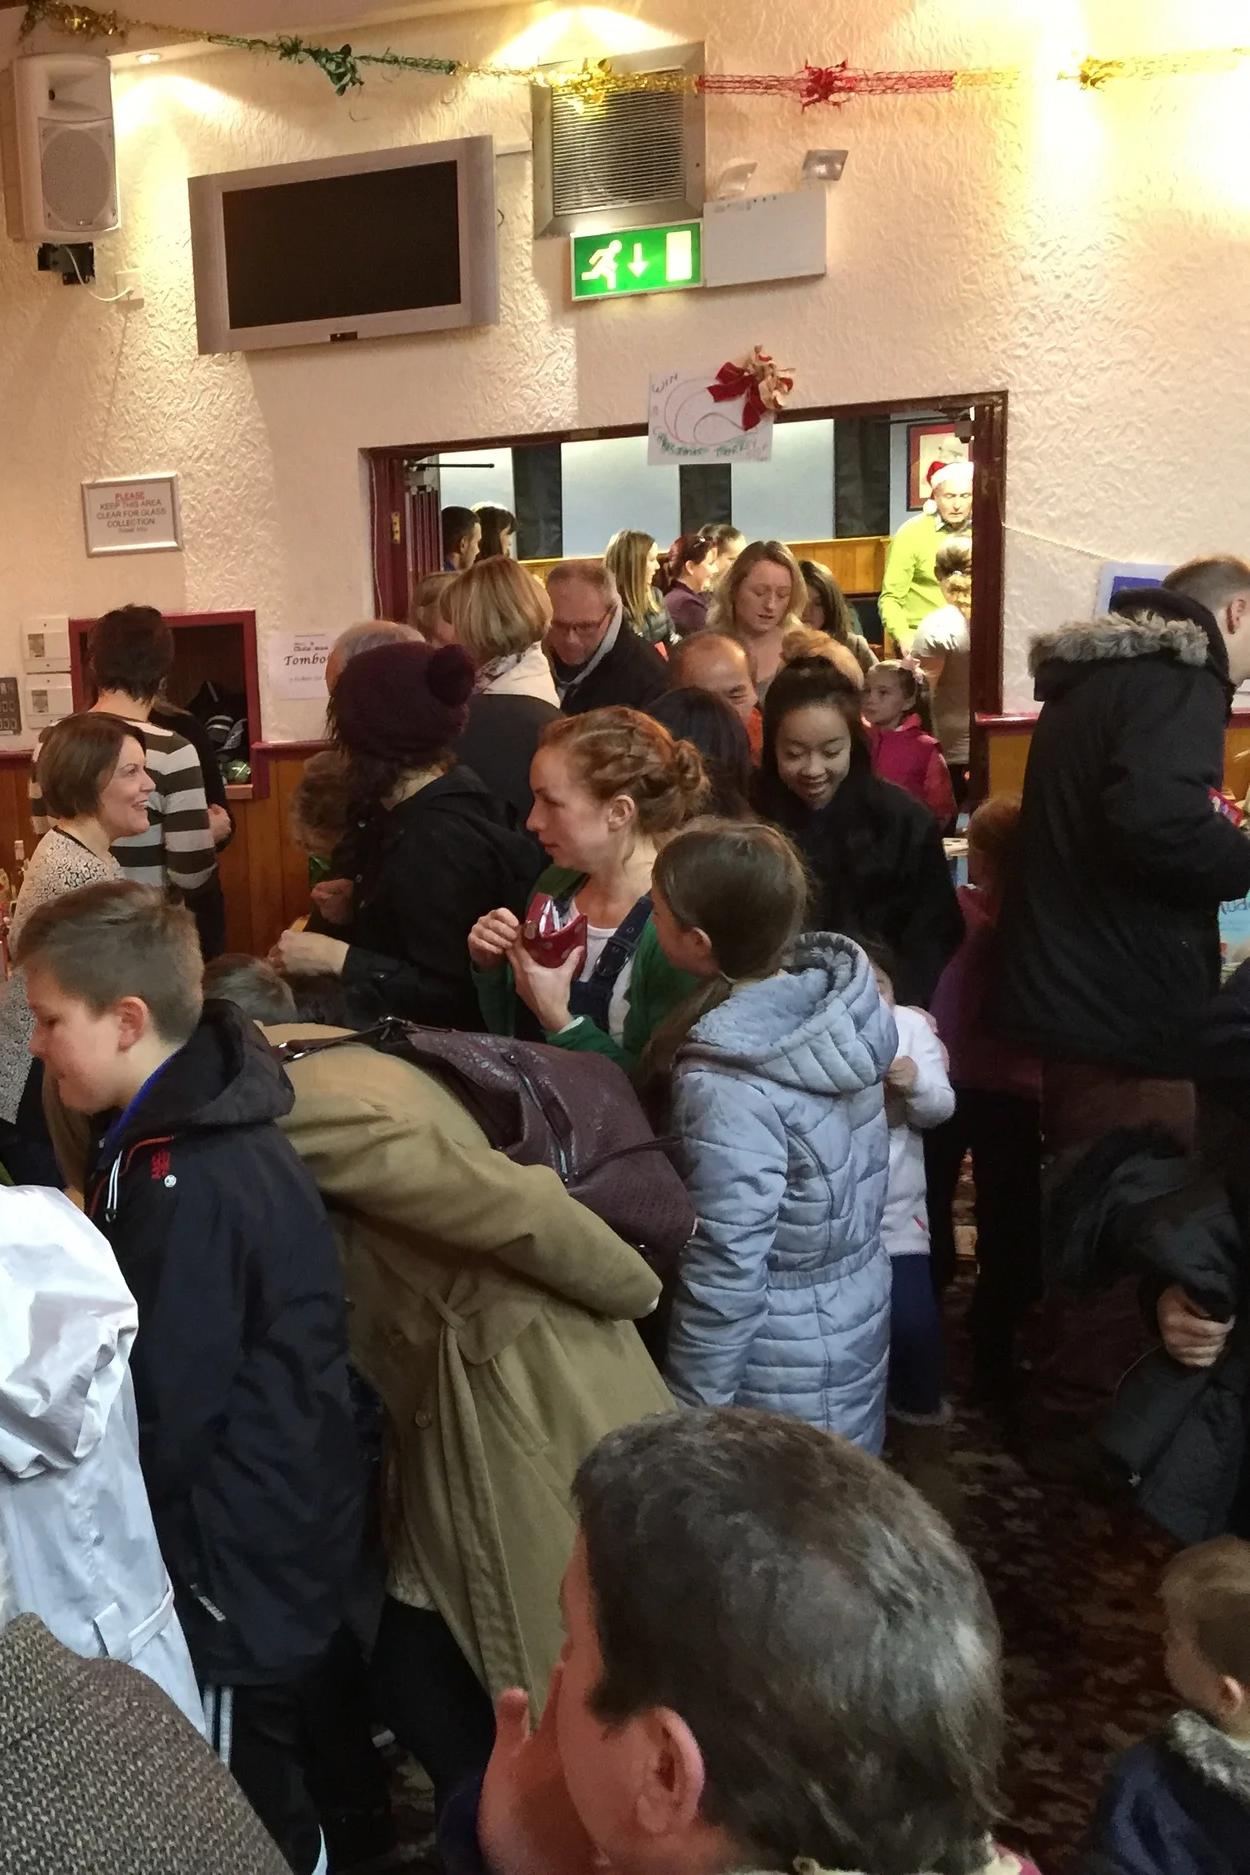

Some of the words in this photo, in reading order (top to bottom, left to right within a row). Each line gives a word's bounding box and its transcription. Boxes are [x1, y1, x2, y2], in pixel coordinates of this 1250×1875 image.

[652, 372, 678, 394] WIN
[114, 490, 145, 501] PLEASE
[99, 502, 120, 511] KEEP
[122, 500, 139, 509] THIS
[141, 498, 162, 507] AREA
[96, 510, 122, 520] CLEAR
[123, 509, 139, 518] FOR
[141, 507, 167, 516] GLASS
[106, 518, 155, 528] COLLECTION
